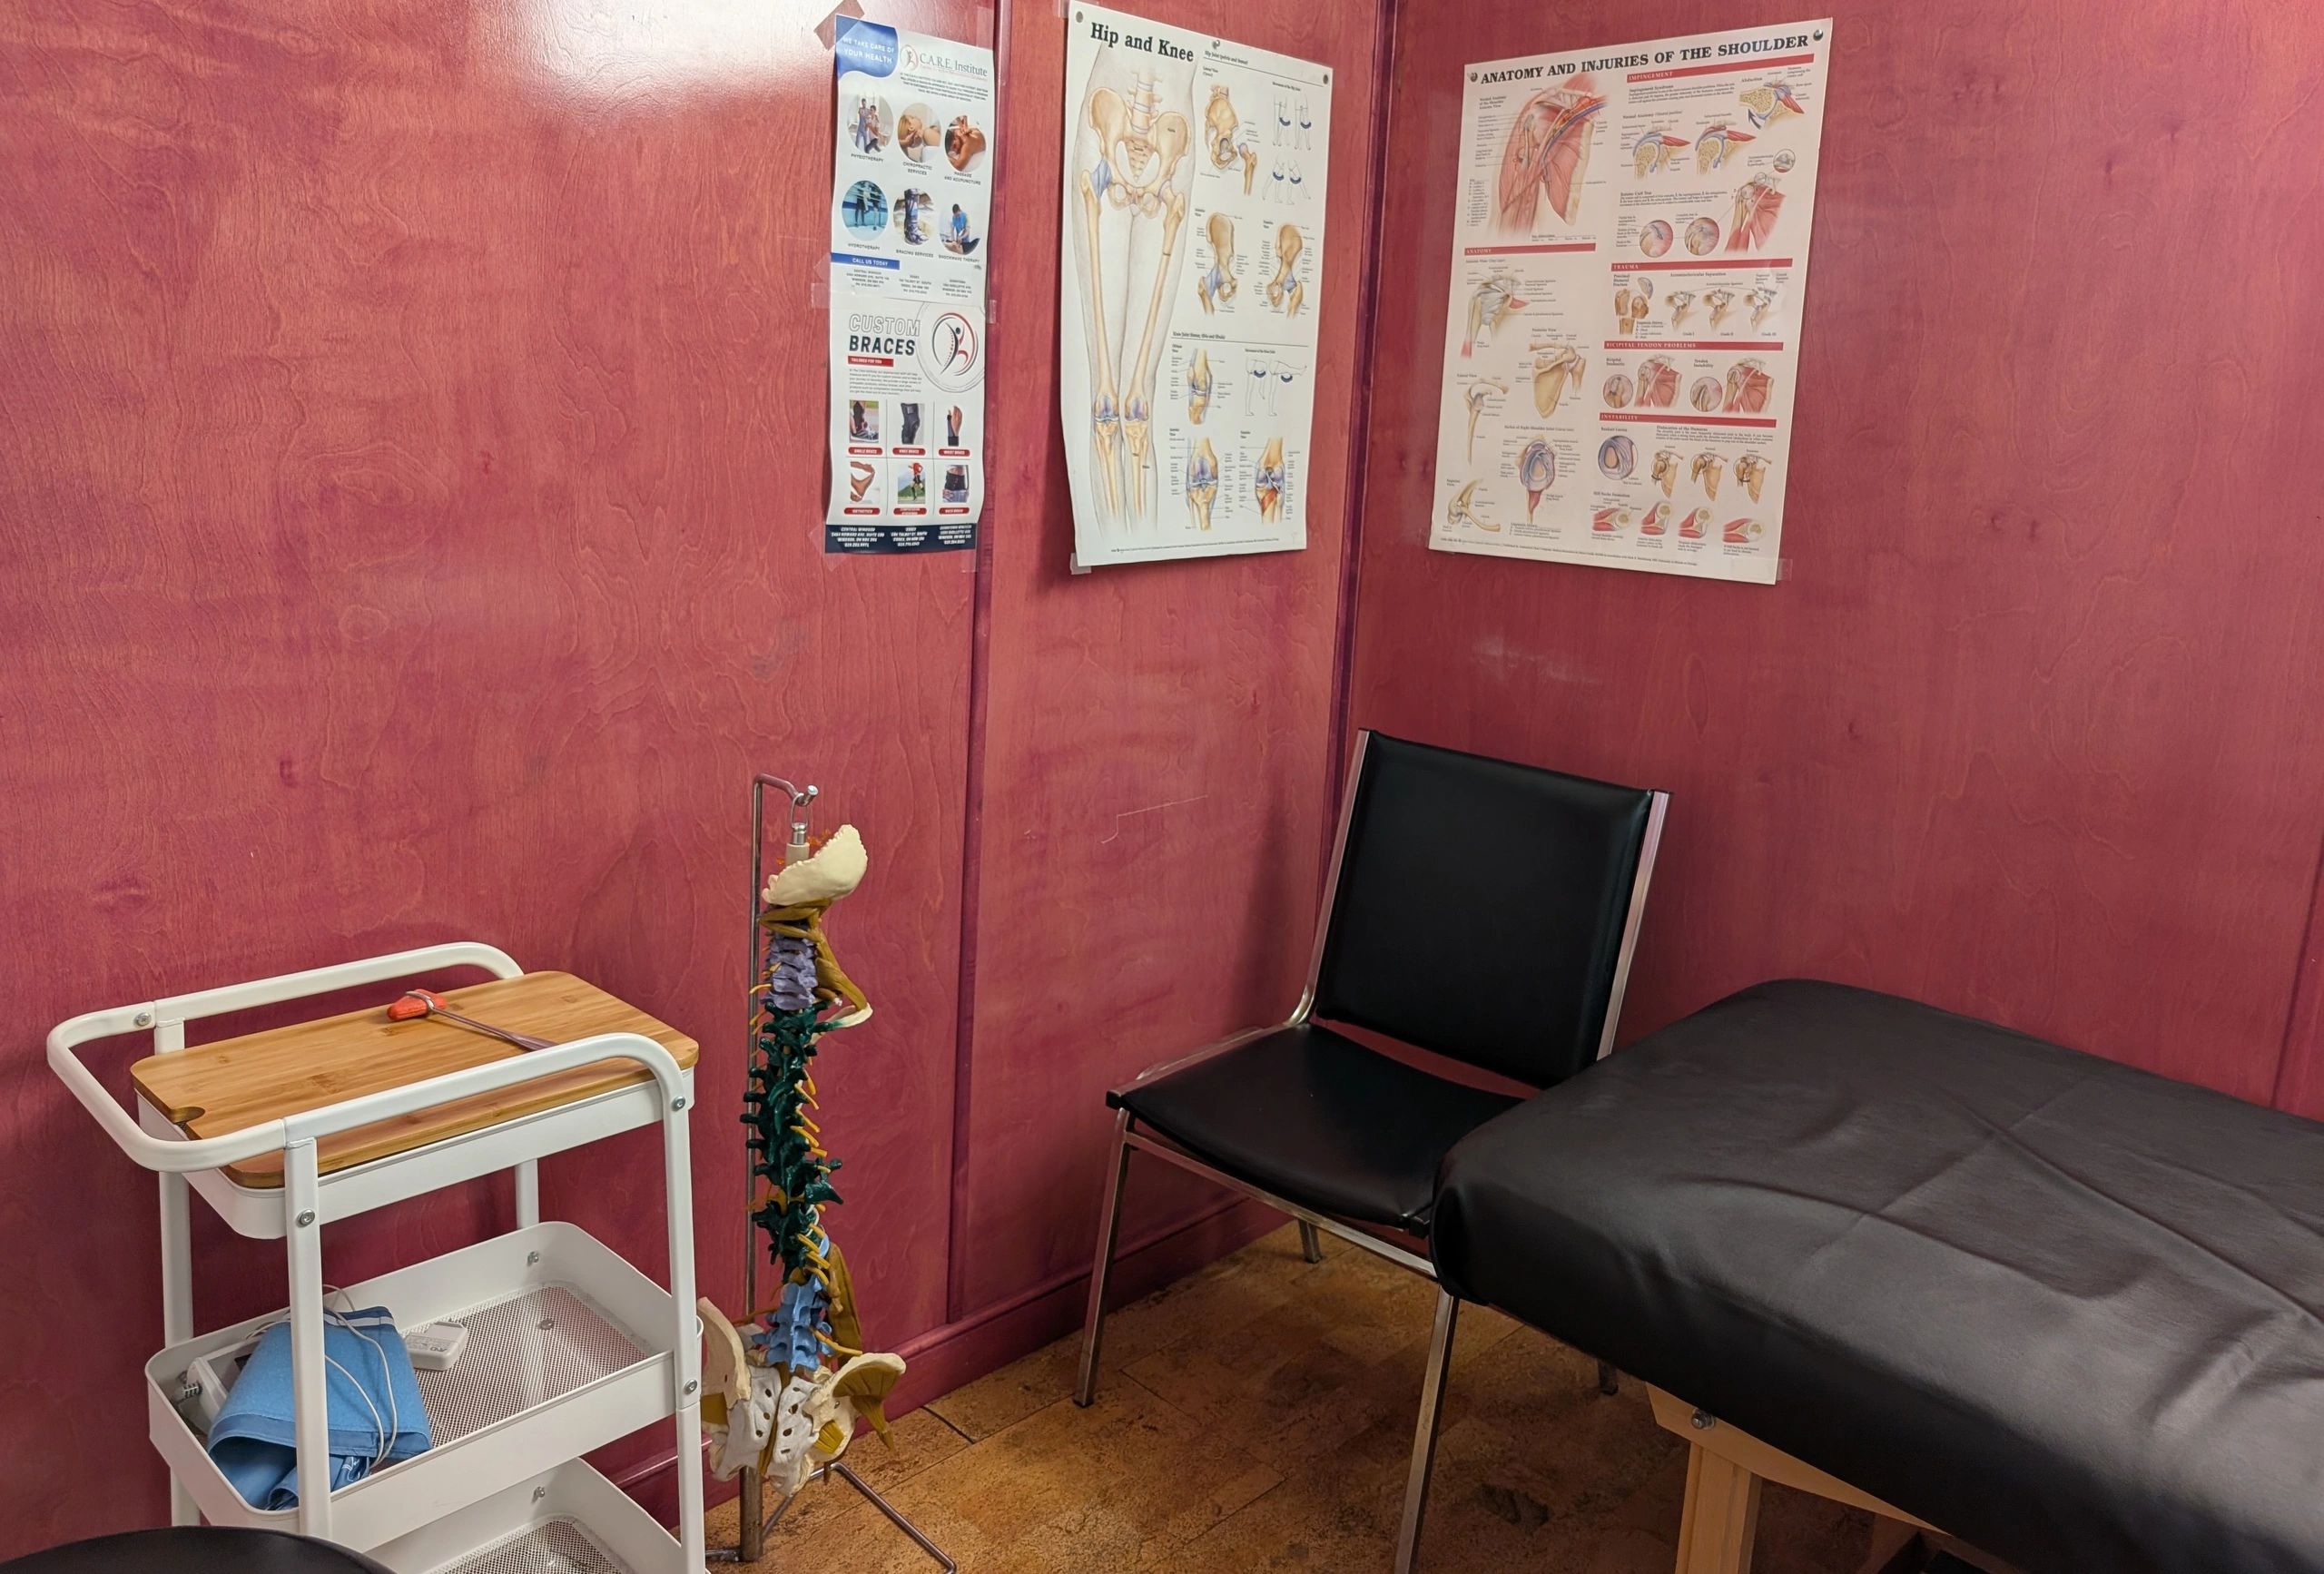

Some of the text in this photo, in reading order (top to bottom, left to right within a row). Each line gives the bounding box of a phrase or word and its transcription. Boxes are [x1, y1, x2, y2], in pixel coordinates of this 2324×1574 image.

[854, 39, 869, 48] TAKE
[870, 43, 886, 52] CARE
[1090, 22, 1194, 62] Hip and Knee
[843, 47, 892, 64] YOUR HEALTH
[920, 53, 988, 76] C.A.R.E. Institute
[1481, 34, 1809, 84] ANATOMY AND INJURIES OF THE SHOULDER
[1629, 71, 1673, 81] IMPINGEMENT
[849, 313, 921, 337] CUSTOM
[849, 335, 916, 356] BRACES
